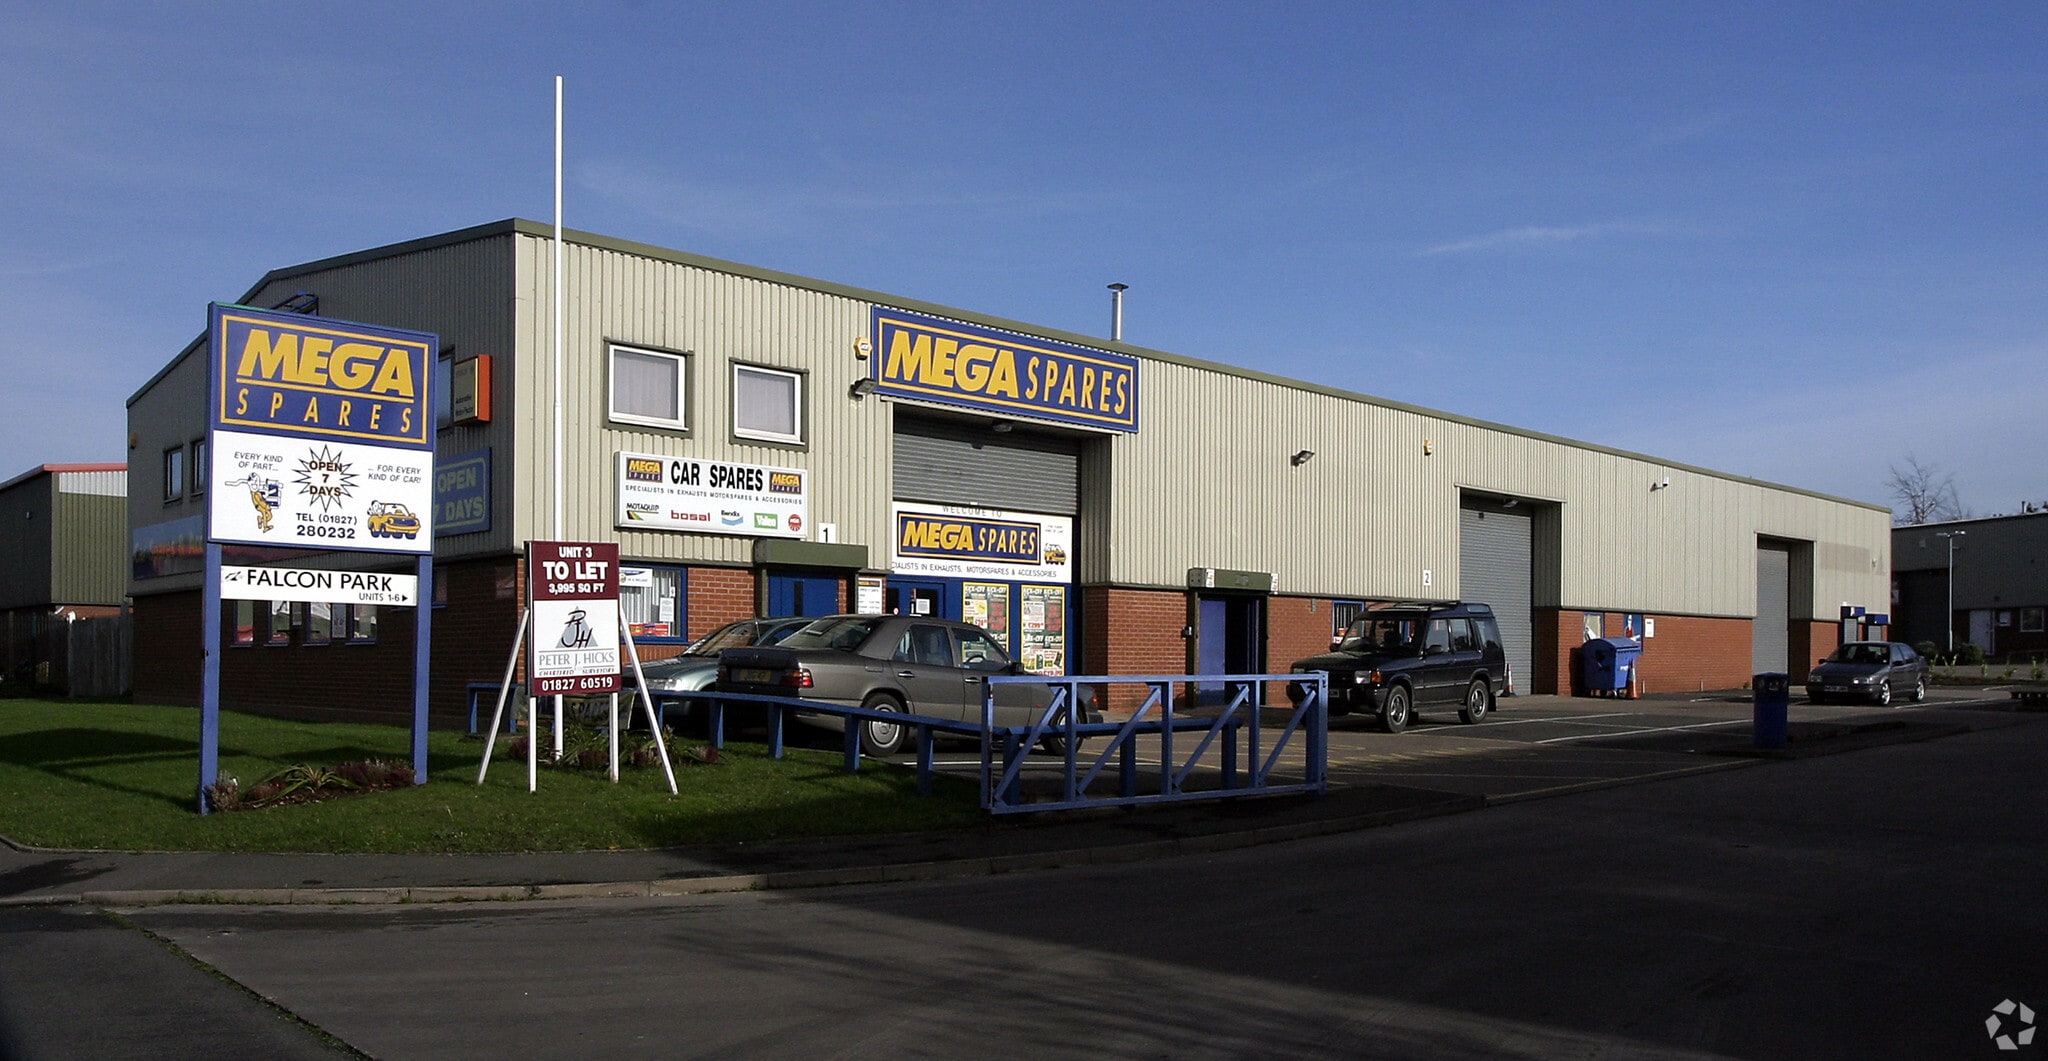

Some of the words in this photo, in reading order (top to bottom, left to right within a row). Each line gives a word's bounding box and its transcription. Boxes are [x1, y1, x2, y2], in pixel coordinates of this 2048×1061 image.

[237, 329, 414, 397] MEGA
[885, 329, 1019, 398] MEGA
[1025, 356, 1128, 415] SPARES
[236, 388, 412, 433] SPARES
[234, 451, 261, 461] EVERY
[264, 454, 283, 463] KIND
[309, 460, 342, 472] OPEN
[377, 465, 393, 473] FOR
[396, 466, 421, 475] EVERY
[629, 460, 660, 473] MEGA
[322, 474, 329, 483] 7
[368, 473, 387, 481] KIND
[437, 467, 476, 493] OPEN
[671, 461, 700, 486] CAR
[709, 464, 763, 491] SPARES
[771, 473, 800, 486] MEGA
[309, 485, 342, 497] DAYS
[625, 485, 664, 494] SPECIALISTS
[677, 489, 707, 497] EXHAUSTS
[710, 492, 752, 501] MOTORSPARES
[762, 496, 802, 505] ACCESSORIES
[445, 496, 484, 521] DAYS
[626, 502, 660, 511] MOTAQUIP
[721, 509, 740, 517] Bendix
[943, 505, 986, 517] WELCOME
[296, 513, 314, 522] TEL
[318, 514, 358, 526] (01827)
[671, 509, 711, 522] bosal
[296, 525, 356, 539] 280232
[822, 527, 828, 544] 1
[902, 520, 974, 551] MEGA
[978, 527, 1036, 555] SPARES
[558, 546, 583, 558] UNIT
[585, 546, 593, 558] 3
[542, 561, 569, 580] TO
[575, 561, 608, 580] LET
[966, 566, 1009, 575] MOTORSPARES
[1018, 569, 1056, 577] ACCESSORIES
[247, 569, 332, 588] FALCON
[340, 574, 392, 592] PARK
[1425, 572, 1430, 584] 2
[548, 583, 575, 595] 3,995
[578, 583, 591, 593] SQ
[593, 583, 605, 593] FT
[358, 592, 384, 602] UNITS
[388, 594, 400, 602] 1-6
[539, 654, 570, 666] PETER
[574, 653, 581, 668] J.
[583, 652, 615, 664] HICKS
[541, 679, 575, 692] 01827
[580, 676, 613, 689] 60519
